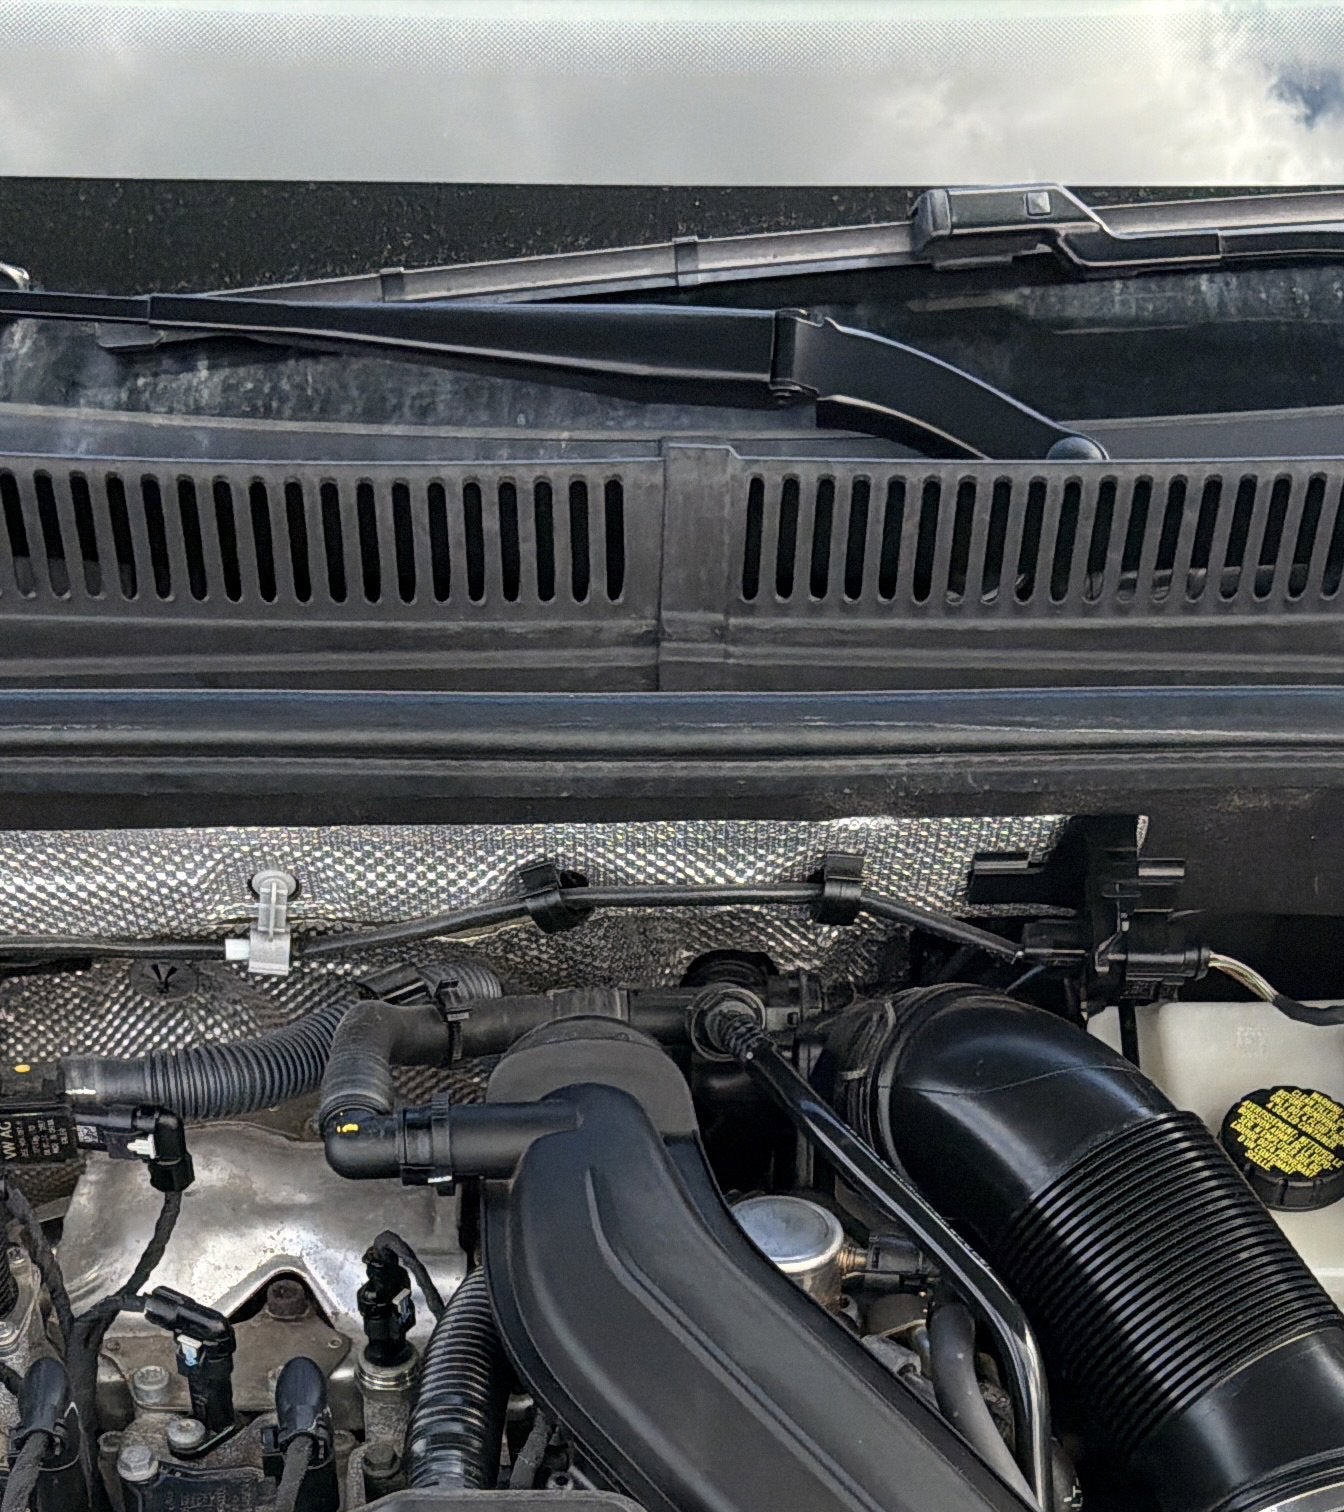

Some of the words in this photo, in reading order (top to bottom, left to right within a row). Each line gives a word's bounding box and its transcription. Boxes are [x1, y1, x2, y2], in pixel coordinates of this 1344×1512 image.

[1268, 1094, 1289, 1109] ONLY
[1286, 1105, 1303, 1117] DOT
[1275, 1088, 1304, 1109] BEFORE
[1291, 1088, 1315, 1106] CLEAN
[1312, 1102, 1338, 1121] FILLER
[1271, 1104, 1300, 1125] SEALED
[1237, 1105, 1272, 1131] BOUCHON
[1269, 1126, 1293, 1144] AVANT
[1290, 1140, 1304, 1151] DE
[1300, 1147, 1313, 1157] LE
[1, 1141, 16, 1158] VW
[1253, 1145, 1296, 1176] CONTENANT
[1297, 1135, 1334, 1162] NETTOYER
[1331, 1157, 1344, 1168] LE
